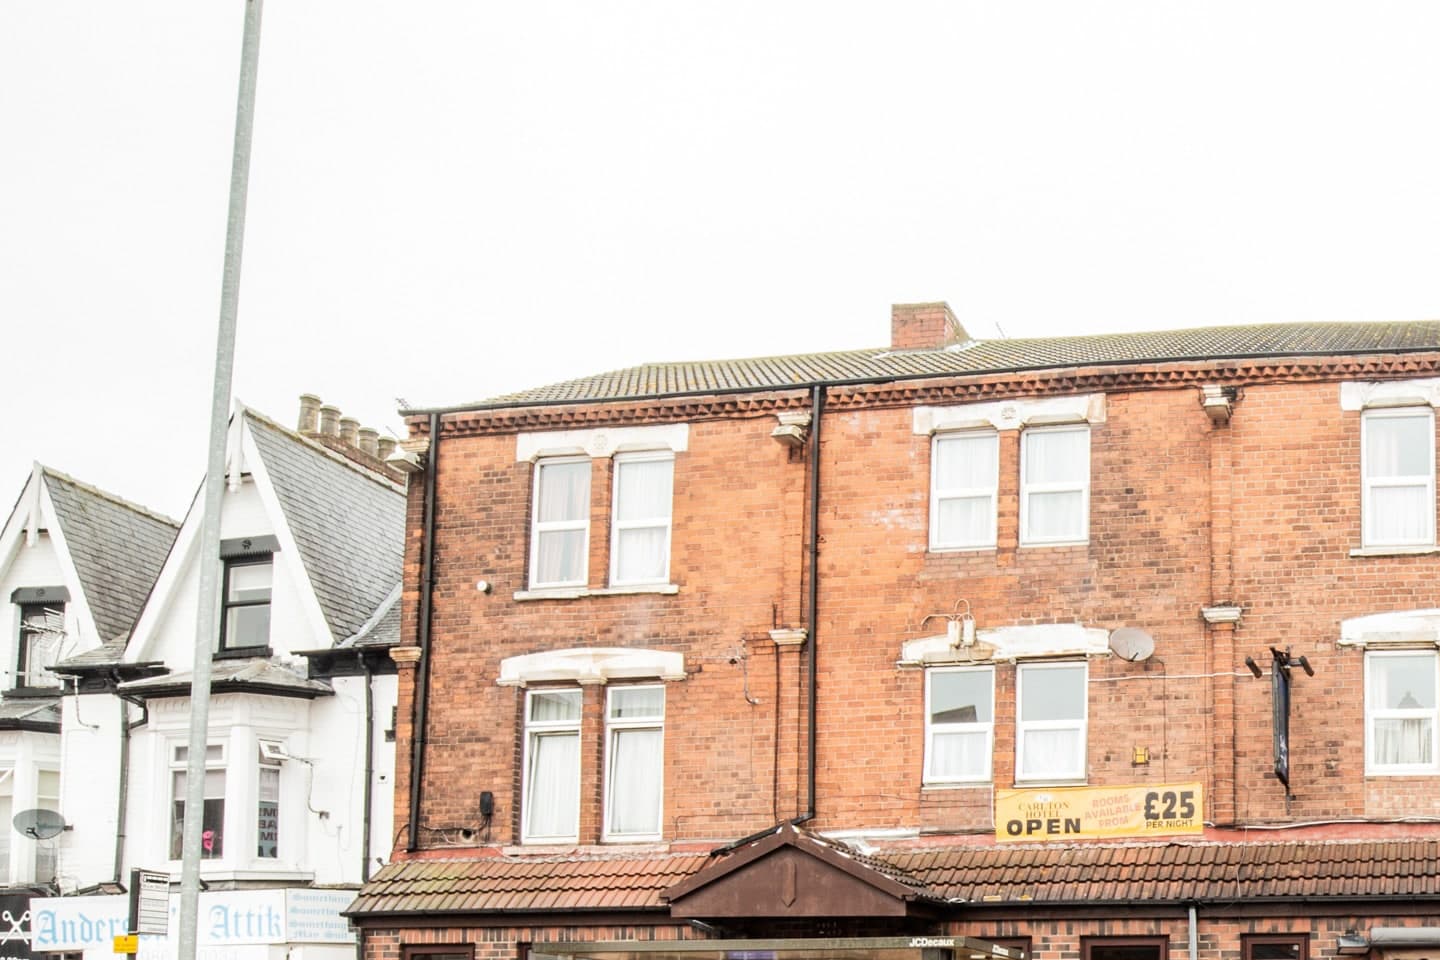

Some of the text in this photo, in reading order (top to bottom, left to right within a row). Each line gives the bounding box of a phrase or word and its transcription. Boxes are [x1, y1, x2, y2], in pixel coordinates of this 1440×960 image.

[1018, 801, 1070, 811] CARLTON
[1092, 794, 1129, 809] ROOMS
[1144, 791, 1195, 820] £25
[1084, 802, 1141, 820] AVAILABLE
[1006, 818, 1081, 836] OPEN
[1098, 816, 1129, 828] FROM
[1145, 819, 1193, 830] PER NIGHT
[209, 904, 282, 939] Attik
[909, 937, 955, 948] JCDecaux
